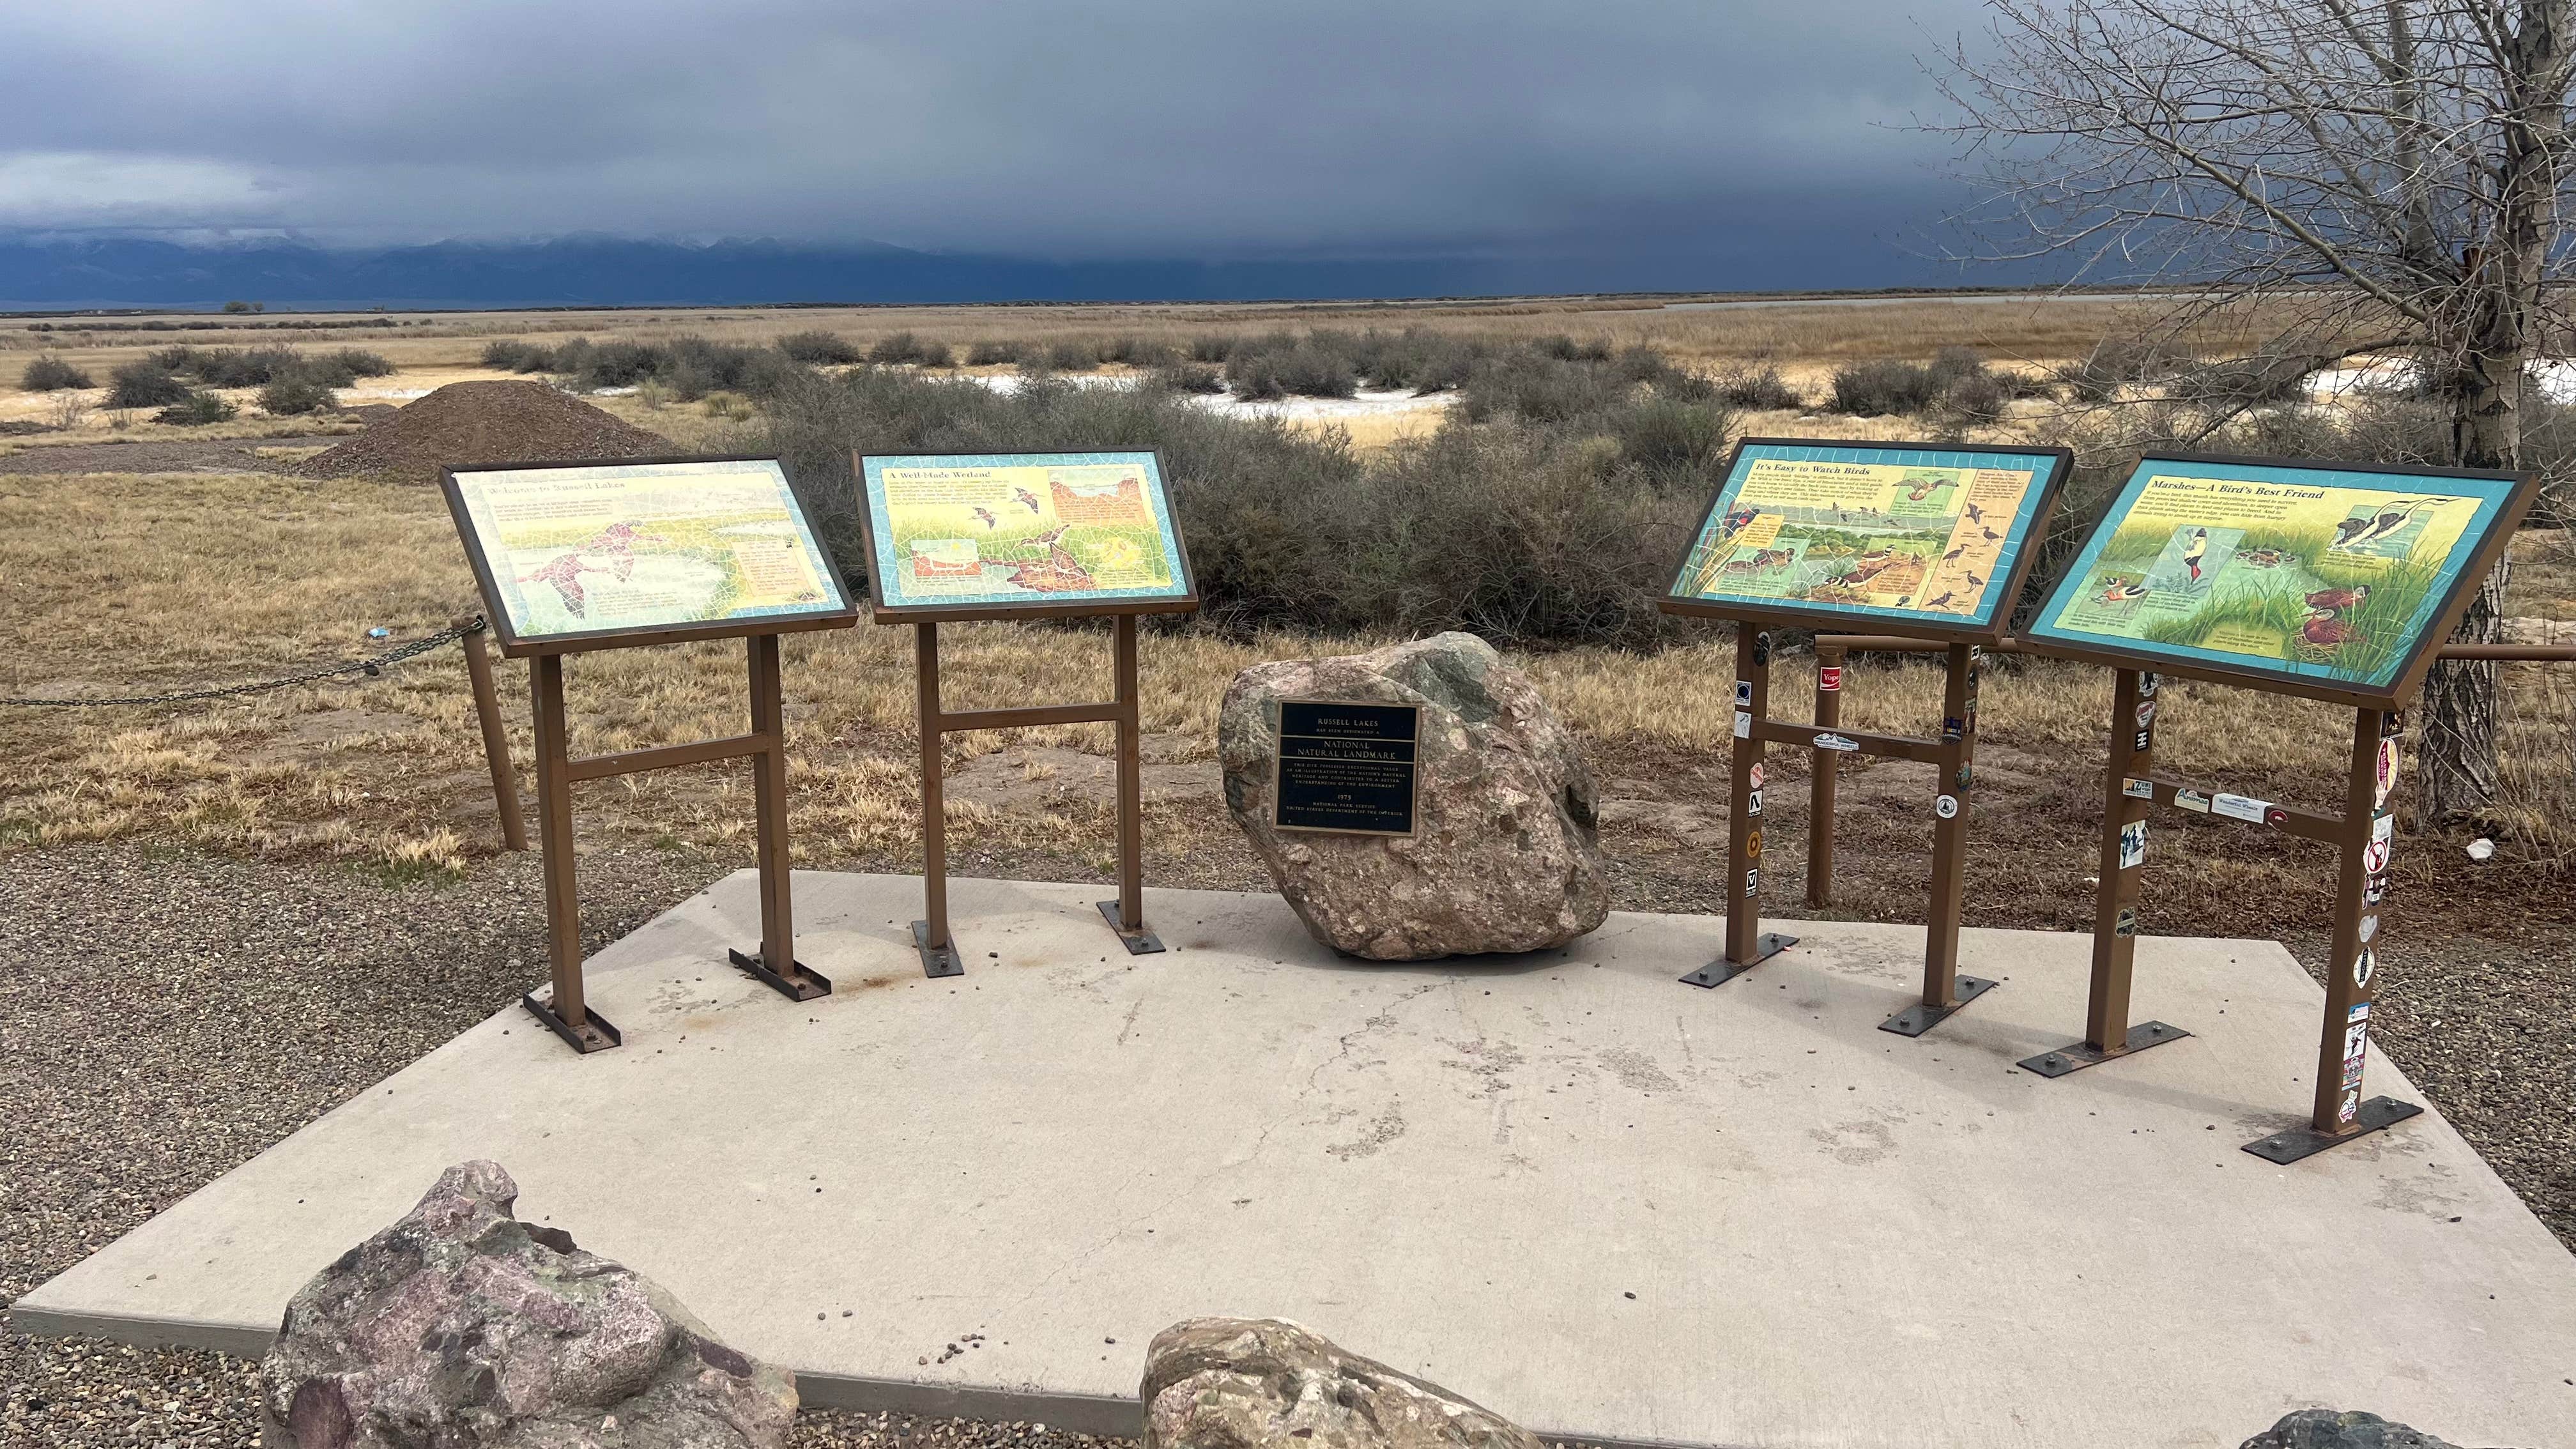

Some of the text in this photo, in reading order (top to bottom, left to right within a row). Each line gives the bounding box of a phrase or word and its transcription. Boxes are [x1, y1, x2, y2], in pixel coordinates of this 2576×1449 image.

[1774, 464, 1797, 473] Easy
[1844, 467, 1871, 475] Birds
[2219, 484, 2253, 494] Bird's
[2256, 487, 2281, 496] Best
[2283, 489, 2325, 500] Friend
[1324, 740, 1370, 749] NATIONAL
[1298, 748, 1396, 760] NATURAL LANDMARK
